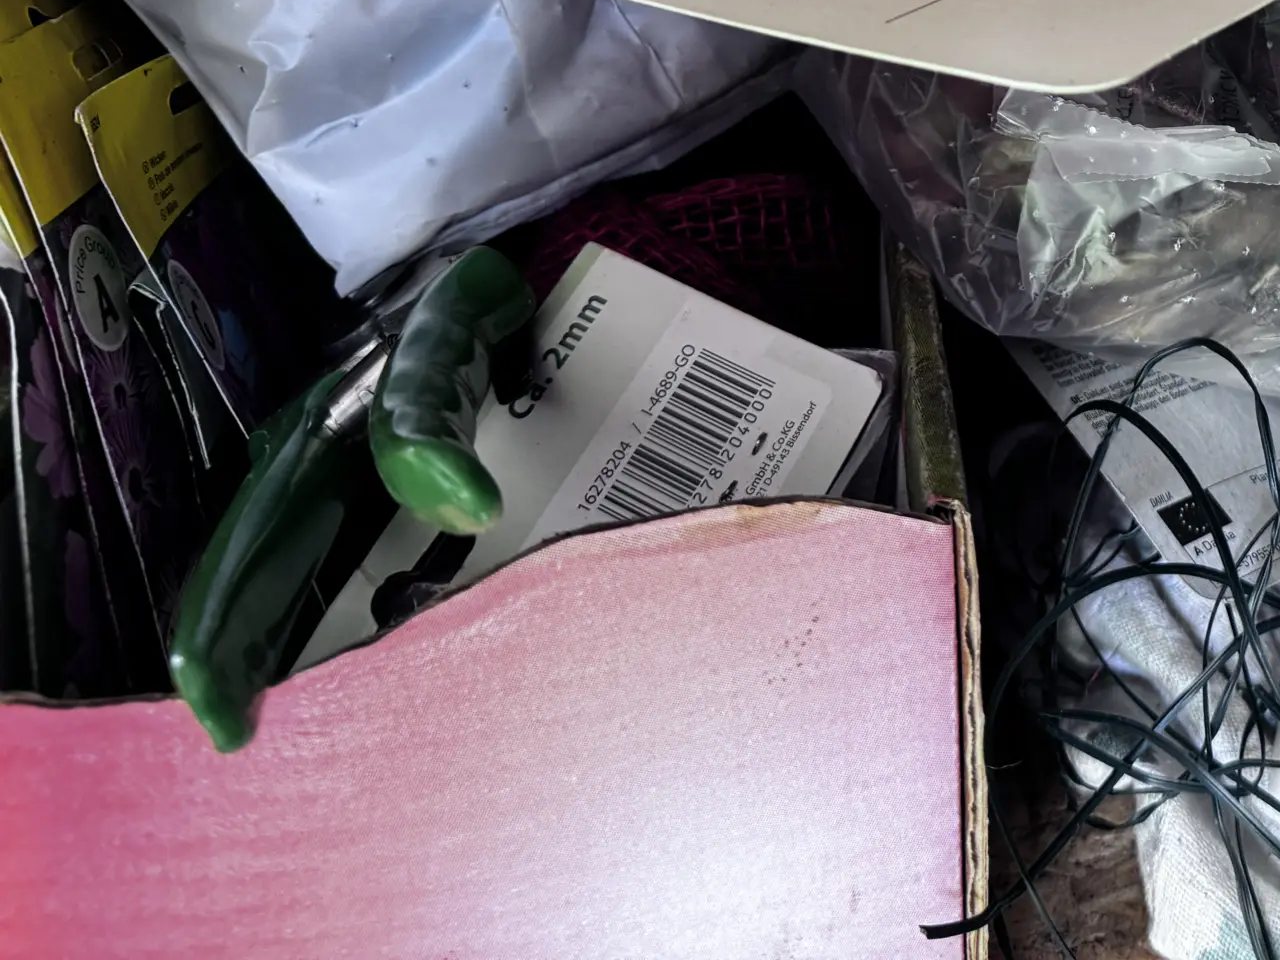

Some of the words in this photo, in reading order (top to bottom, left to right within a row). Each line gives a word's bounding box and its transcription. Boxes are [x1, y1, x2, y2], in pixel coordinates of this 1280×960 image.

[76, 247, 89, 295] Price
[93, 273, 120, 334] A
[503, 364, 555, 426] Ca.
[540, 285, 609, 373] 2mm
[575, 436, 635, 517] 16278204
[640, 339, 698, 419] I-4689-GO
[1069, 392, 1086, 405] DE:
[743, 459, 772, 497] GmbH
[769, 417, 797, 453] Co.KG
[760, 446, 792, 487] D-49143
[783, 399, 820, 449] Bissendorf
[1148, 489, 1175, 509] DAHLIA
[1201, 528, 1238, 553] Daia
